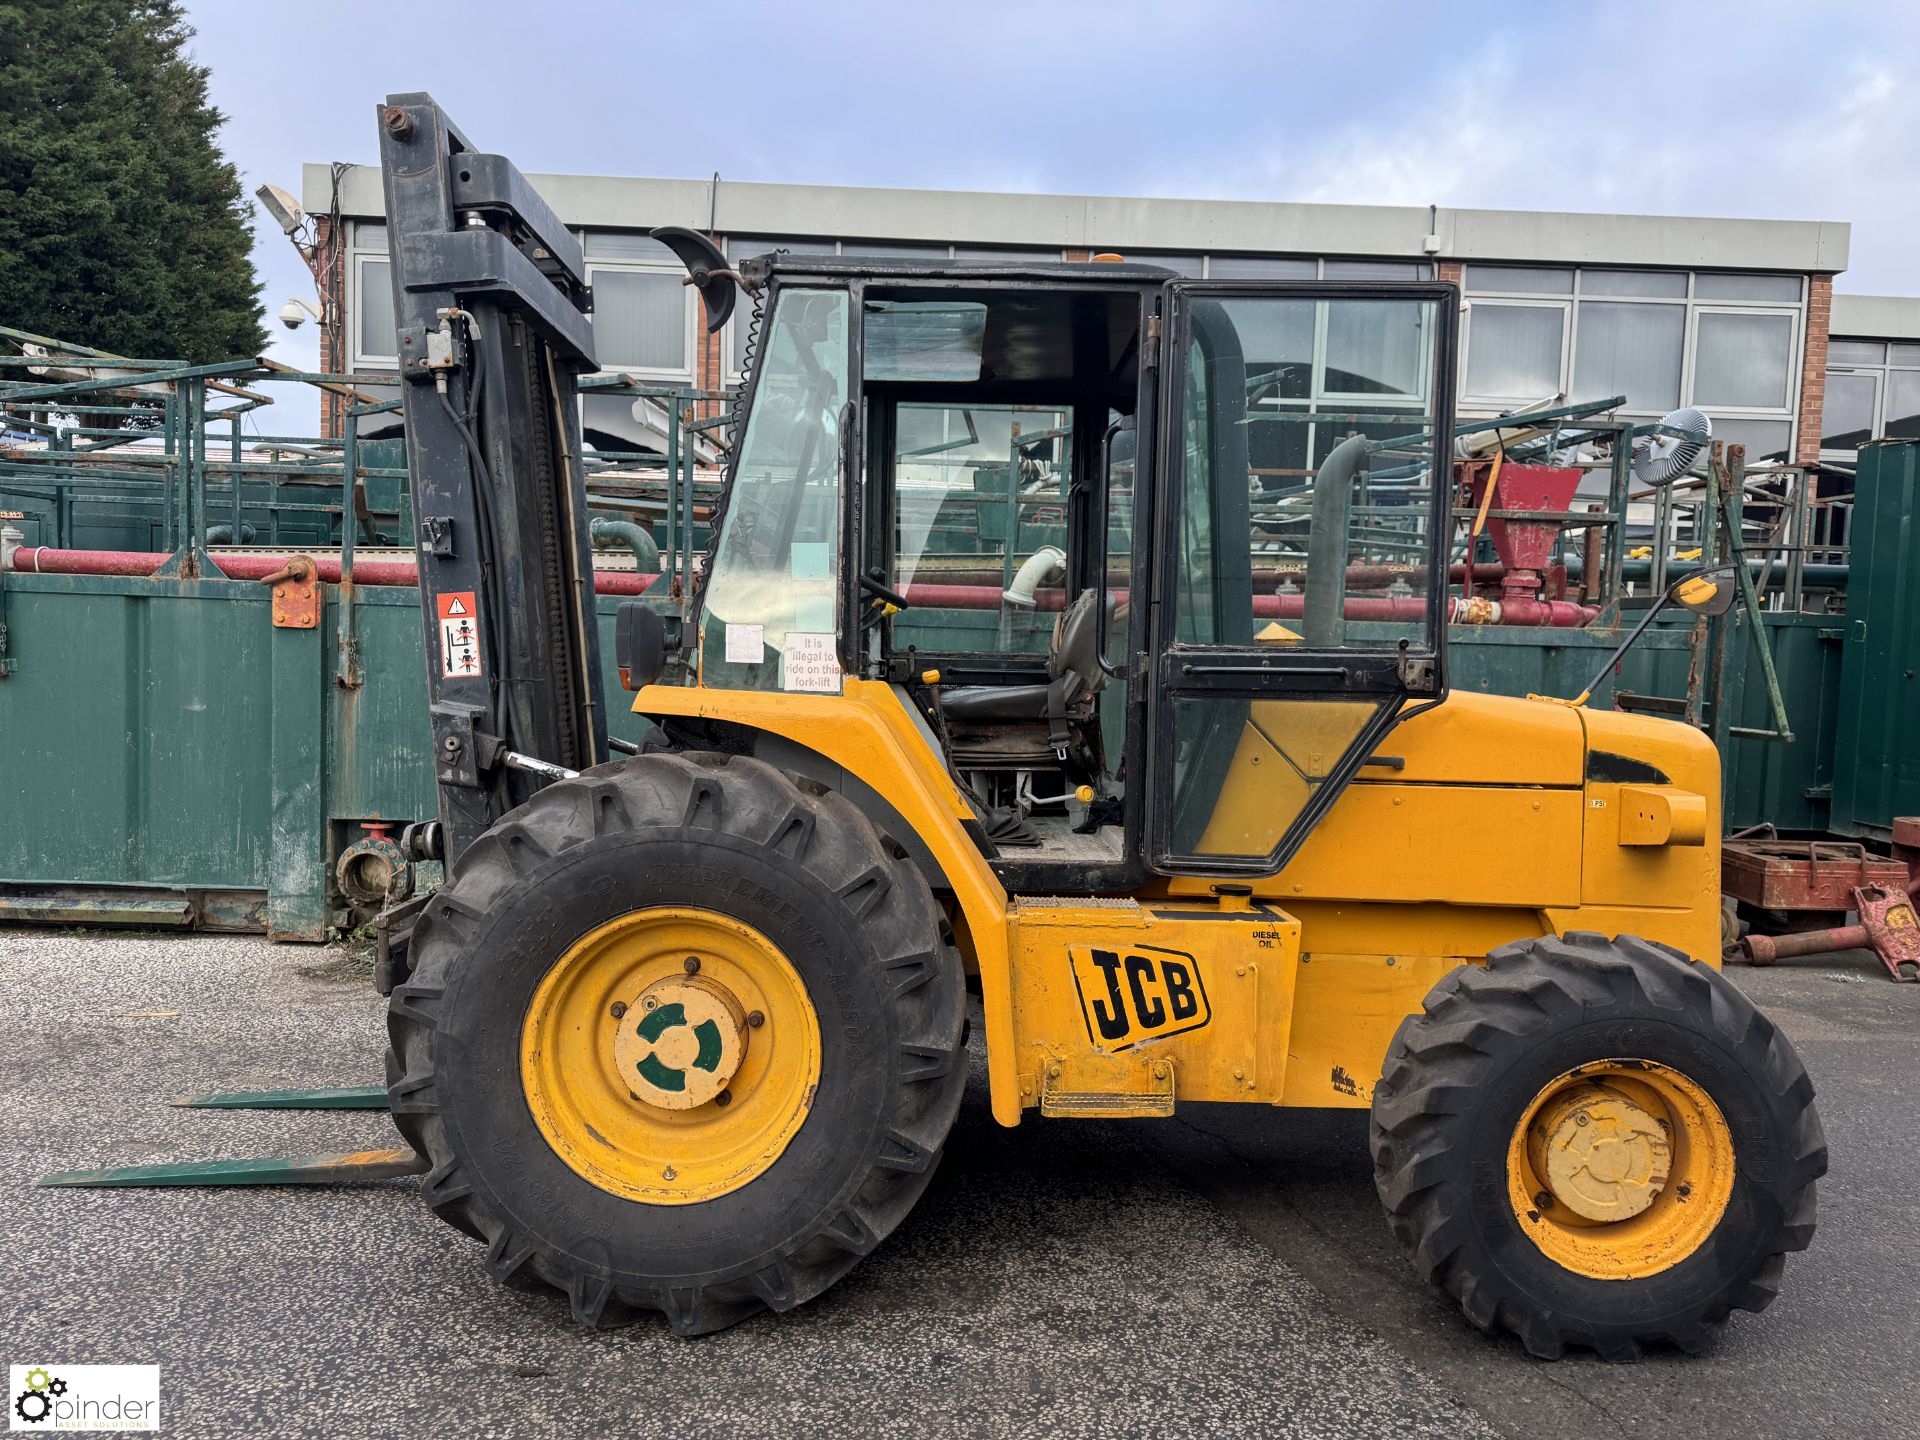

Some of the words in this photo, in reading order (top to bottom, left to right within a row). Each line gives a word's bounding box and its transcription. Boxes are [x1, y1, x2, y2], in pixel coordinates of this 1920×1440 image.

[804, 638, 811, 648] It
[813, 638, 823, 648] is
[792, 651, 822, 663] illegal
[824, 651, 834, 661] to
[785, 664, 804, 674] ride
[807, 666, 820, 674] on
[822, 664, 840, 675] this
[795, 677, 831, 687] fork-lift
[1252, 931, 1281, 940] DIESEL
[1258, 940, 1275, 949] OIL
[1091, 949, 1198, 1040] JCB
